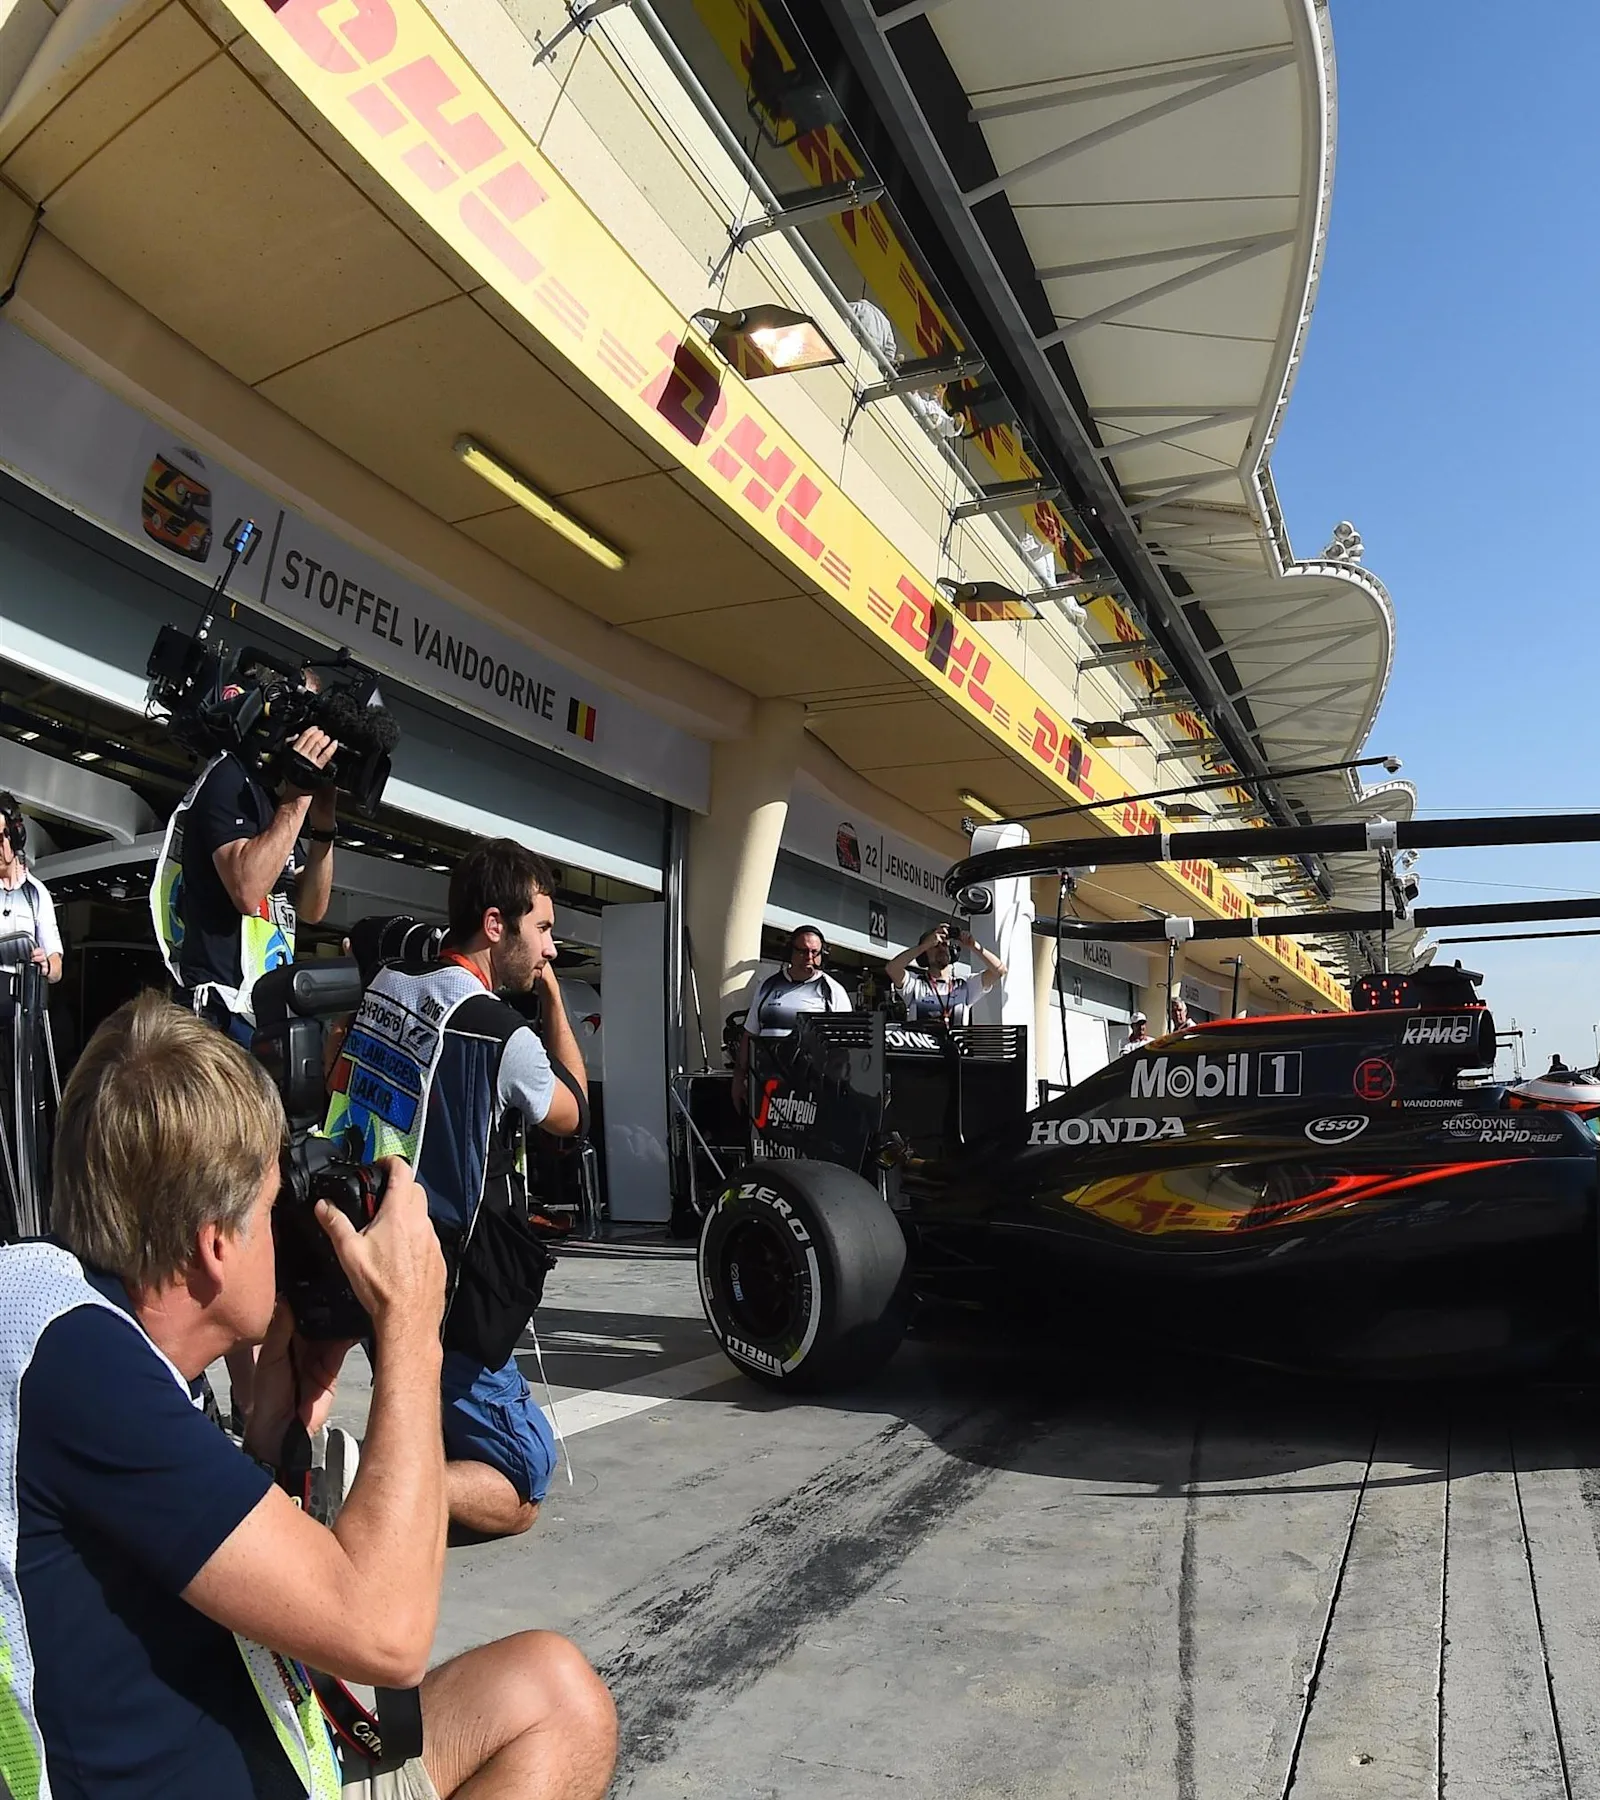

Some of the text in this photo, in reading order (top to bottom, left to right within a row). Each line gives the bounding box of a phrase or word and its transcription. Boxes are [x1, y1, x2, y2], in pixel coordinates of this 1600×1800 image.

[639, 330, 825, 560] DHL
[281, 550, 556, 721] STOFFEL VANDOORNE
[891, 575, 994, 714] DHL
[1032, 707, 1094, 800] DHL
[865, 845, 878, 868] 22
[885, 853, 921, 886] JENSON
[871, 912, 885, 937] 28
[1083, 942, 1112, 969] McLAREN
[421, 995, 444, 1022] 2016
[885, 1030, 940, 1050] DYNE
[1402, 1026, 1470, 1045] KPMG
[1131, 1053, 1249, 1098] Mobil
[1403, 1099, 1463, 1108] VANDOORNE
[1027, 1116, 1188, 1145] HONDA
[1441, 1118, 1516, 1131] SENSODYNE
[1478, 1130, 1563, 1143] RAPID RELIEF
[738, 1183, 811, 1242] ZERO
[727, 1334, 783, 1378] PIRELLI
